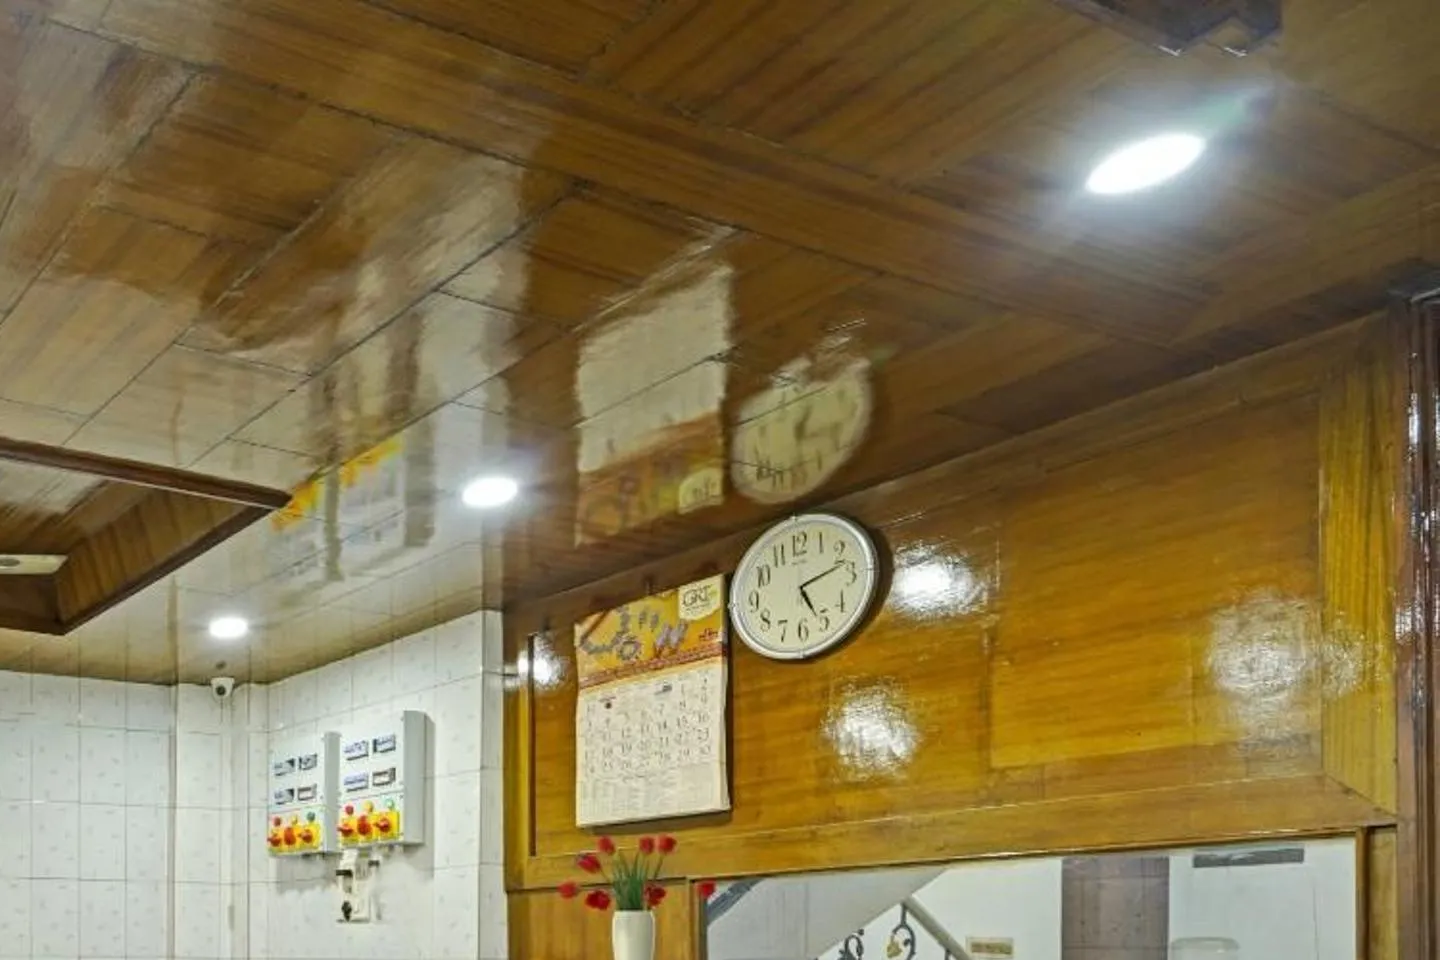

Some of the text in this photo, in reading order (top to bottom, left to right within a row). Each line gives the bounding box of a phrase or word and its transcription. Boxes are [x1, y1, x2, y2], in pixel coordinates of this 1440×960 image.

[792, 531, 808, 557] 12
[818, 531, 825, 554] 1
[833, 540, 846, 565] 2
[773, 543, 786, 568] 11
[756, 563, 771, 588] 10
[845, 559, 857, 586] 3
[748, 590, 759, 613] 9
[834, 589, 845, 613] 4
[759, 608, 771, 632] 8
[777, 619, 788, 643] 7
[797, 617, 809, 642] 6
[818, 608, 830, 632] 5
